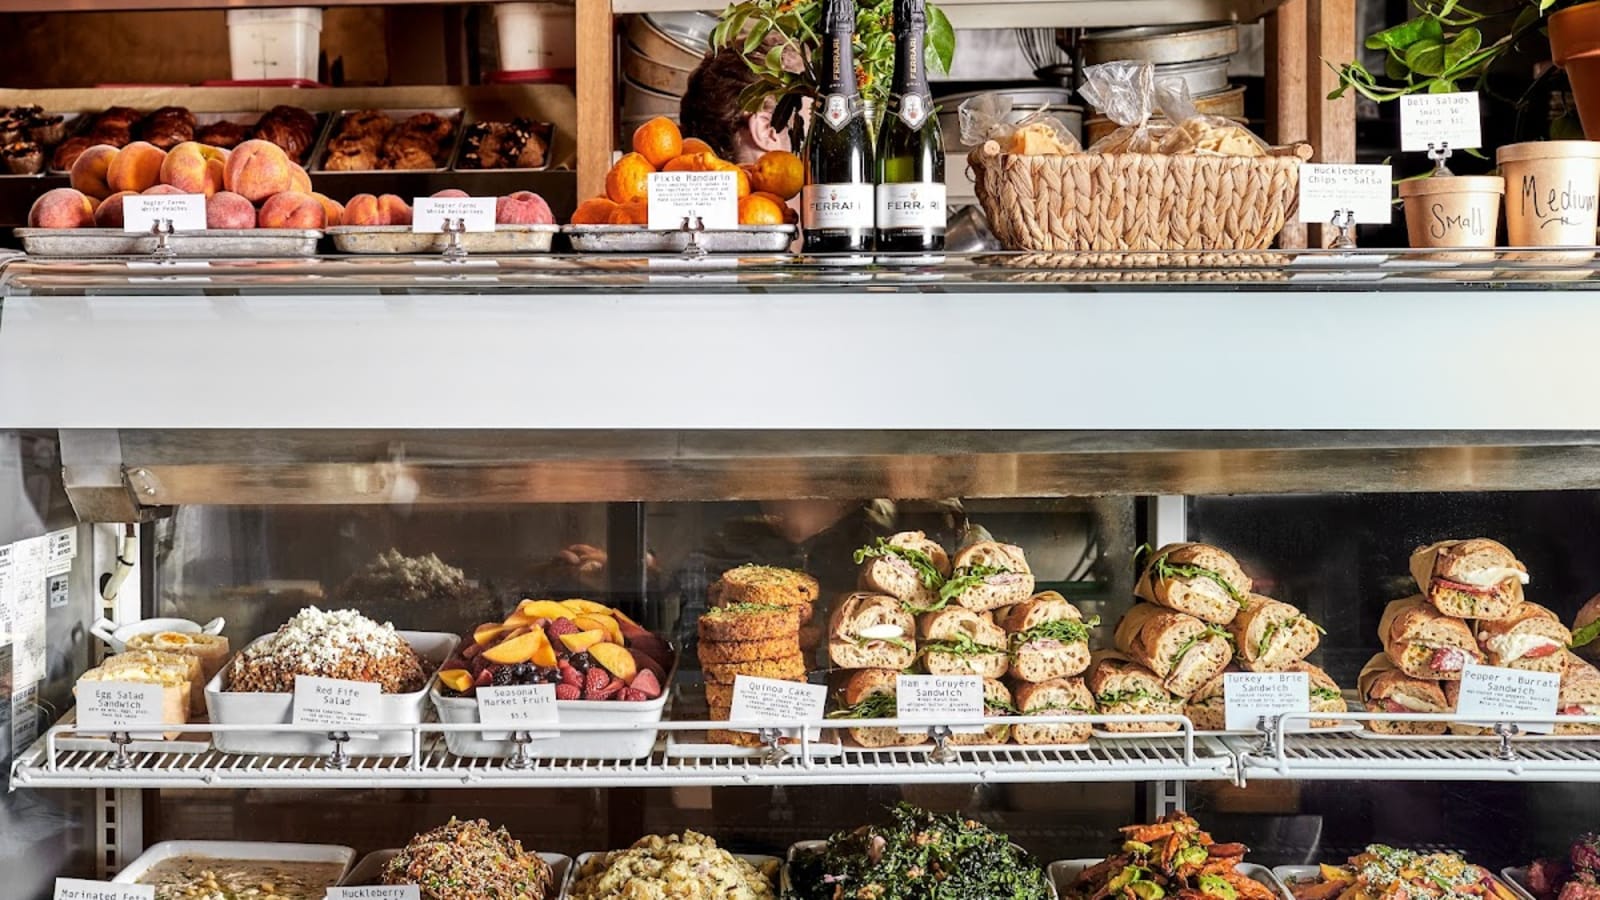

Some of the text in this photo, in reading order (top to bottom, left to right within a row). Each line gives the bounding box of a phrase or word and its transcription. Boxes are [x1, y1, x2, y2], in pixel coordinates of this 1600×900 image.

[1314, 167, 1376, 176] Huckleberry
[654, 174, 730, 182] Pixie Mandarin
[1308, 176, 1337, 184] Chips
[1354, 176, 1383, 184] Salsa
[1521, 175, 1596, 219] Medium
[887, 201, 940, 210] FERRRI
[1228, 674, 1262, 683] Turkey
[1280, 674, 1303, 682] Brie
[1464, 670, 1500, 682] Pepper
[1518, 676, 1559, 688] Burrata
[935, 679, 976, 688] Gruyère
[1242, 684, 1289, 692] Sandwich
[316, 685, 360, 697] Red Fife
[494, 688, 538, 697] Seasonal
[748, 682, 784, 694] Quinoa
[788, 687, 812, 698] Cake
[916, 688, 962, 696] Sandwich
[1488, 682, 1535, 695] Sandwich
[96, 689, 144, 700] Egg Salad
[98, 700, 141, 708] Sandwich
[323, 696, 351, 706] Salad
[484, 696, 550, 706] Market Fruit
[62, 888, 116, 900] Marinated
[342, 889, 405, 898] Huckleberry
